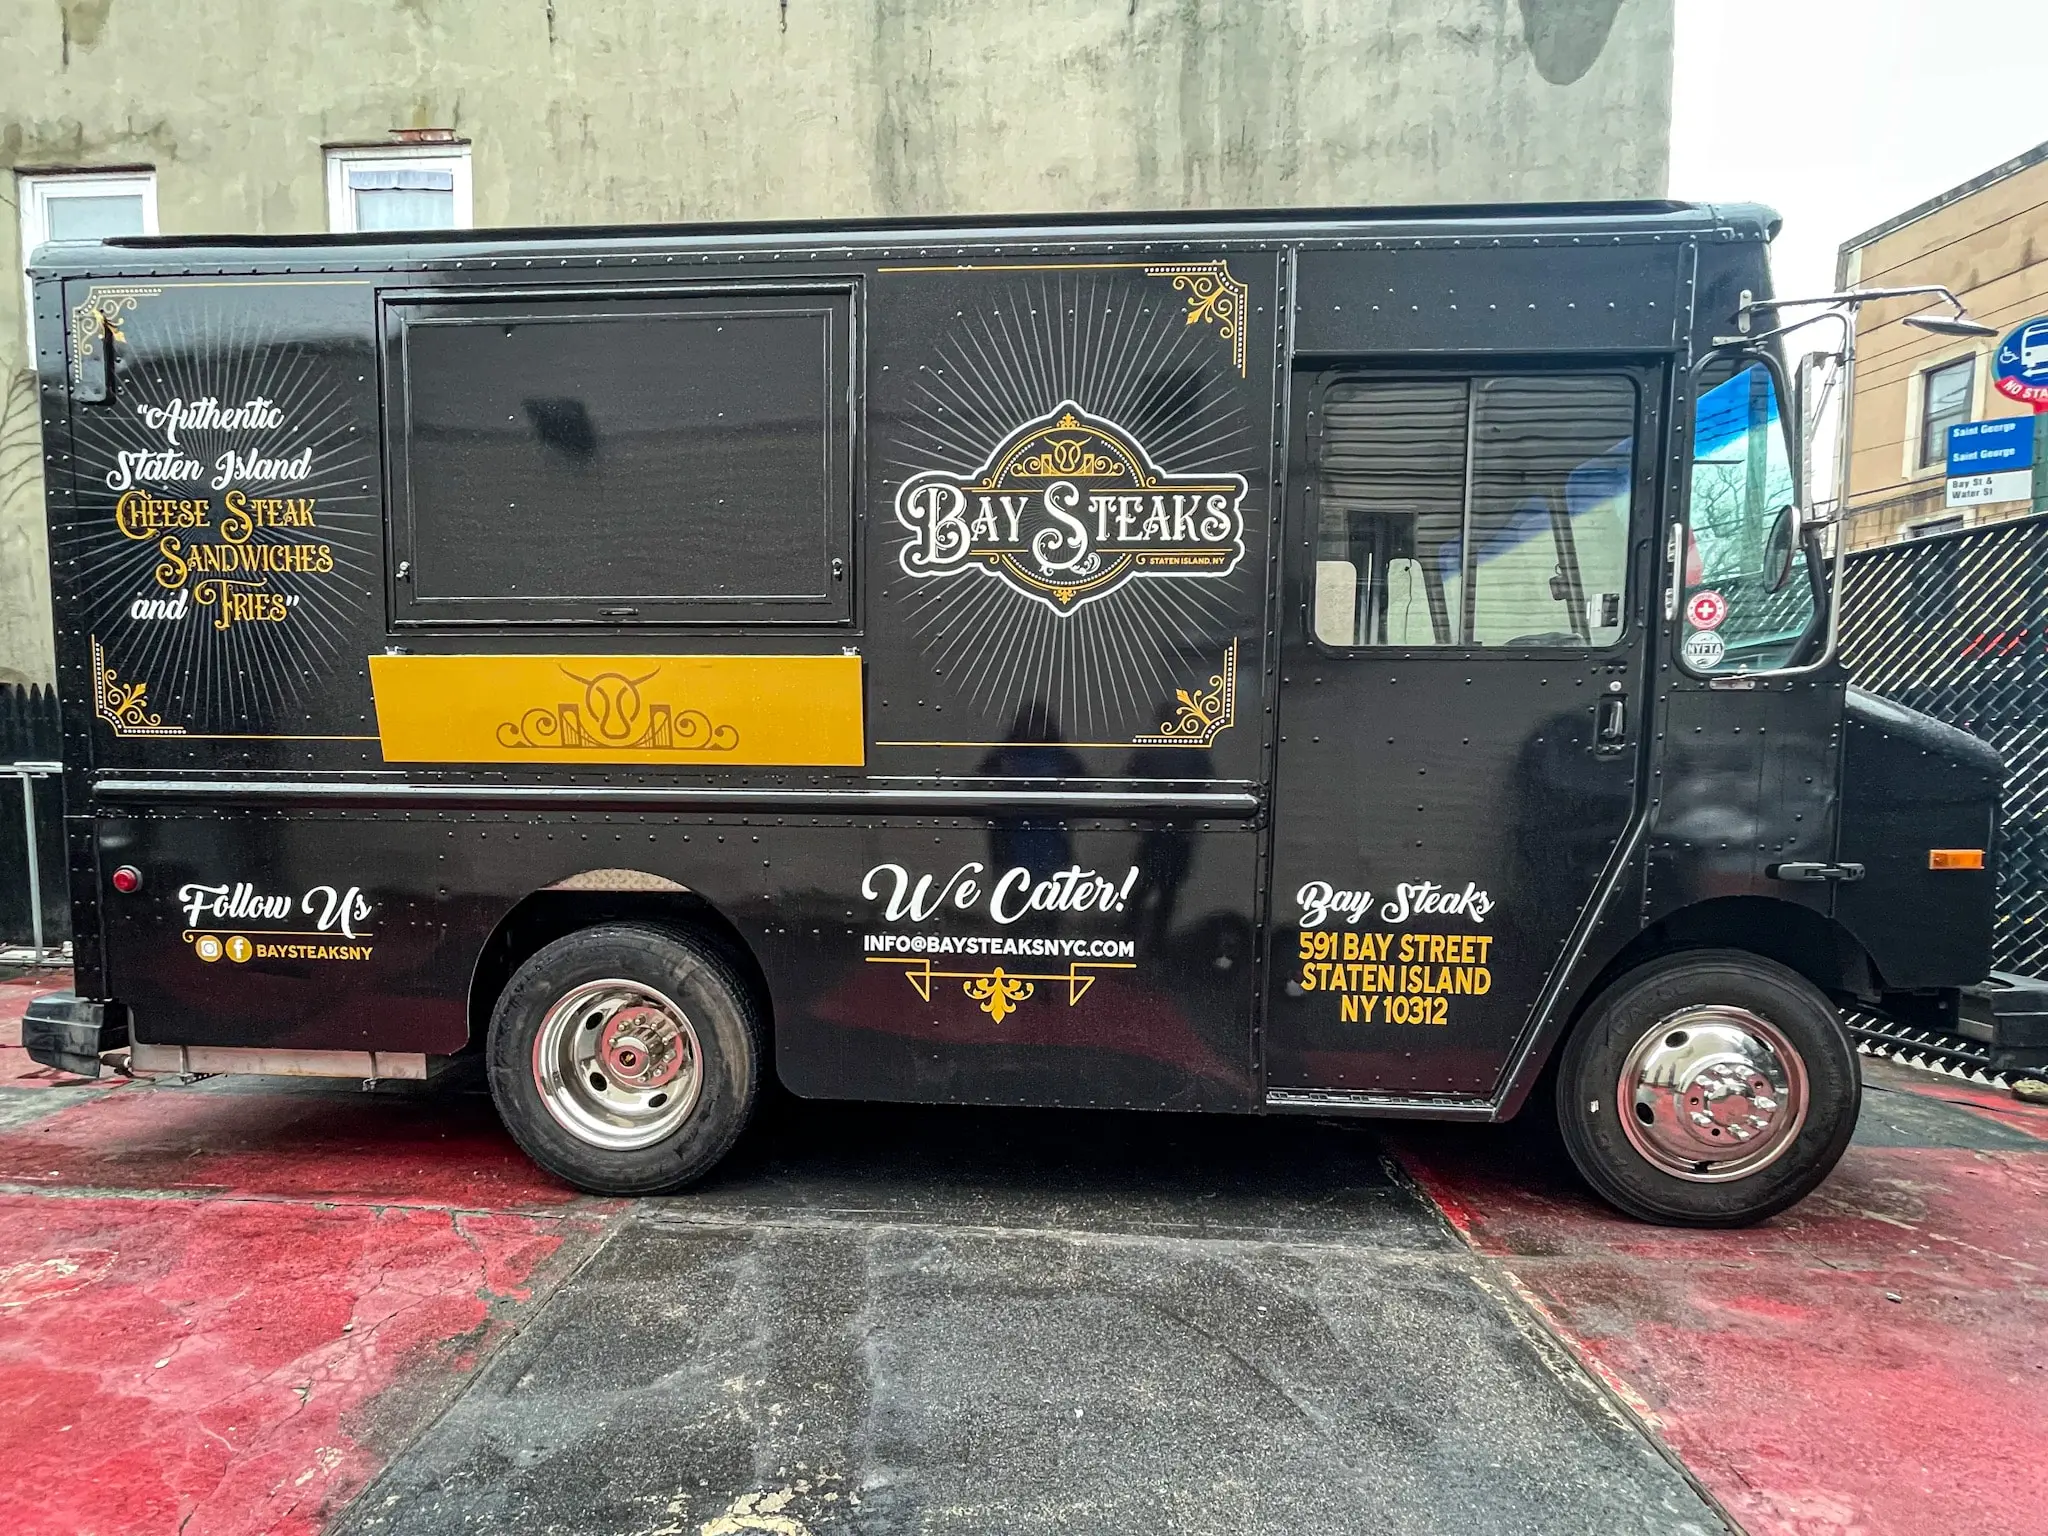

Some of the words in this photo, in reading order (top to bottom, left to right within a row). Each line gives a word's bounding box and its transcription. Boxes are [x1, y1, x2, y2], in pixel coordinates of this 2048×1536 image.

[2003, 380, 2023, 394] NO
[1953, 427, 1978, 438] Saint
[1980, 422, 2016, 434] George
[106, 448, 204, 490] Staten
[211, 447, 312, 490] Island
[1952, 451, 1978, 462] Saint
[1980, 447, 2016, 459] George
[1952, 479, 1970, 489] Bay
[1973, 478, 1982, 487] St
[1986, 476, 1993, 485] &
[1952, 490, 1980, 499] Water
[1983, 488, 1993, 496] St
[116, 489, 211, 540] CHEESE
[220, 490, 316, 544] STEAK
[907, 483, 1029, 565] BAY
[1032, 481, 1231, 575] STEAKS
[155, 535, 334, 588] SANDWICHES
[1150, 557, 1180, 565] STATEN
[1212, 557, 1225, 565] NY
[131, 589, 188, 620] and
[1687, 643, 1722, 655] NYFTA
[861, 862, 984, 922] We
[989, 864, 1140, 924] Cater!
[1296, 880, 1374, 928] Bay
[1381, 880, 1495, 924] Steaks
[179, 882, 291, 927] Follow
[301, 885, 373, 939] Us
[256, 943, 374, 961] BAYSTEAKSNY
[863, 934, 1135, 958] INFO@BAYSTEAKSNYC.COM
[1299, 931, 1338, 960] 591
[1343, 932, 1395, 961] BAY
[1398, 933, 1493, 964] STREET
[1300, 962, 1395, 993] STATEN
[1400, 964, 1492, 995] ISLAND
[1341, 994, 1382, 1023] NY
[1383, 995, 1448, 1025] 10312
